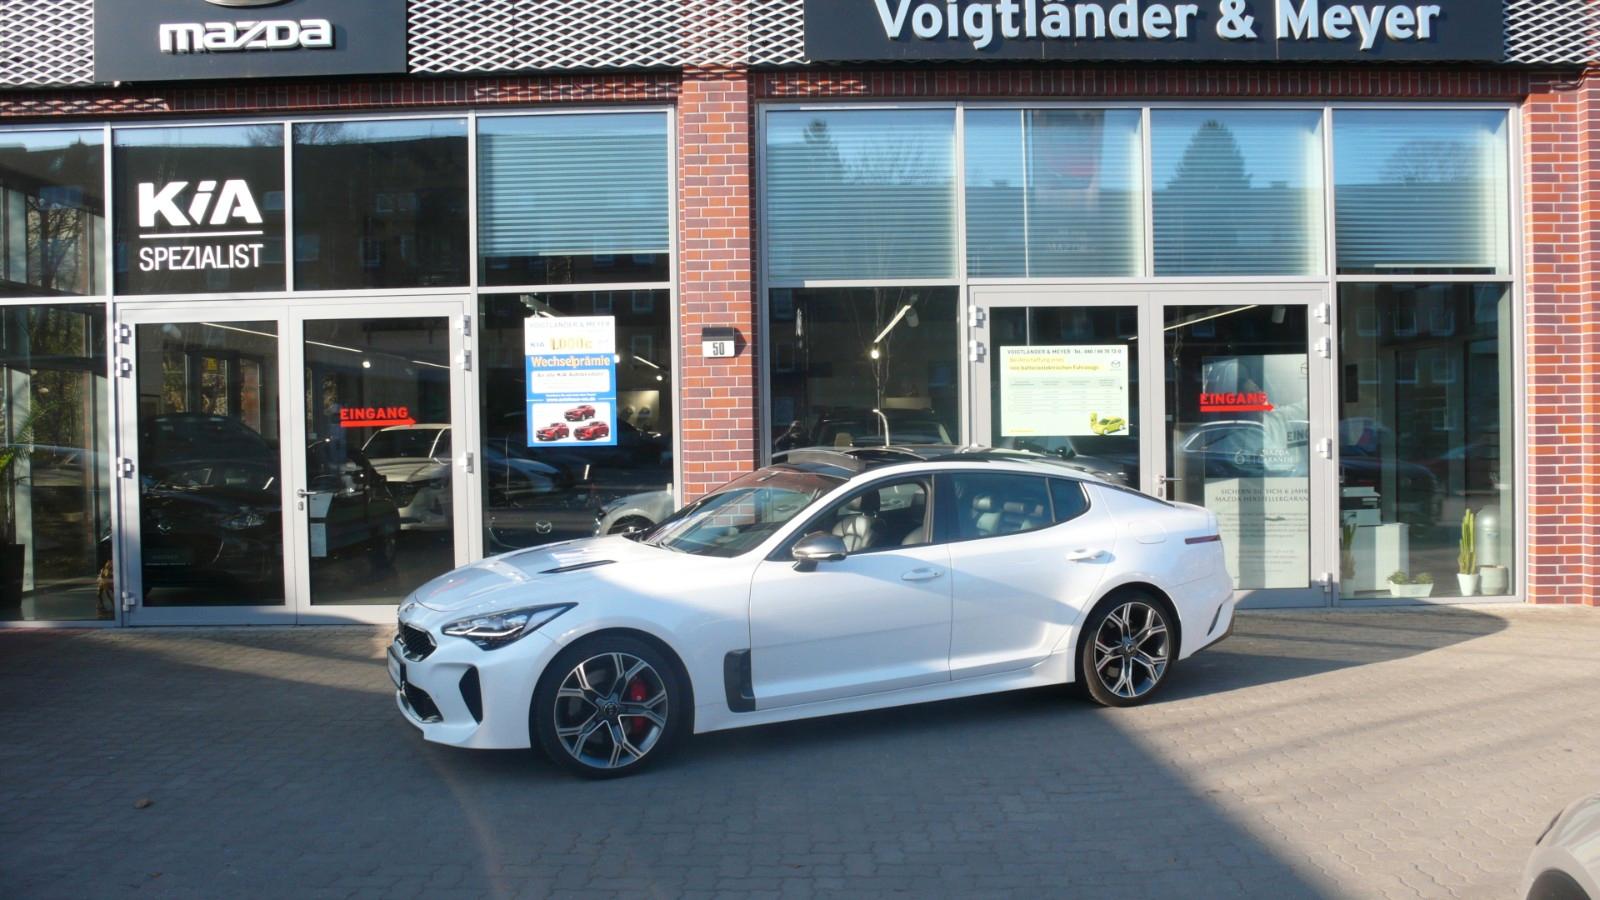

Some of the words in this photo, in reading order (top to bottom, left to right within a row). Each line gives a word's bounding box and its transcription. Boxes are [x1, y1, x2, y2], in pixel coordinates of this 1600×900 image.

[874, 0, 1199, 50] Voigtländer
[1216, 0, 1258, 41] &
[1275, 0, 1441, 50] Meyer
[139, 243, 264, 272] SPEZIALIST
[712, 341, 725, 356] 50
[531, 355, 610, 369] Wechselprämie
[1200, 392, 1268, 405] EINGANG
[340, 406, 409, 420] EINGANG
